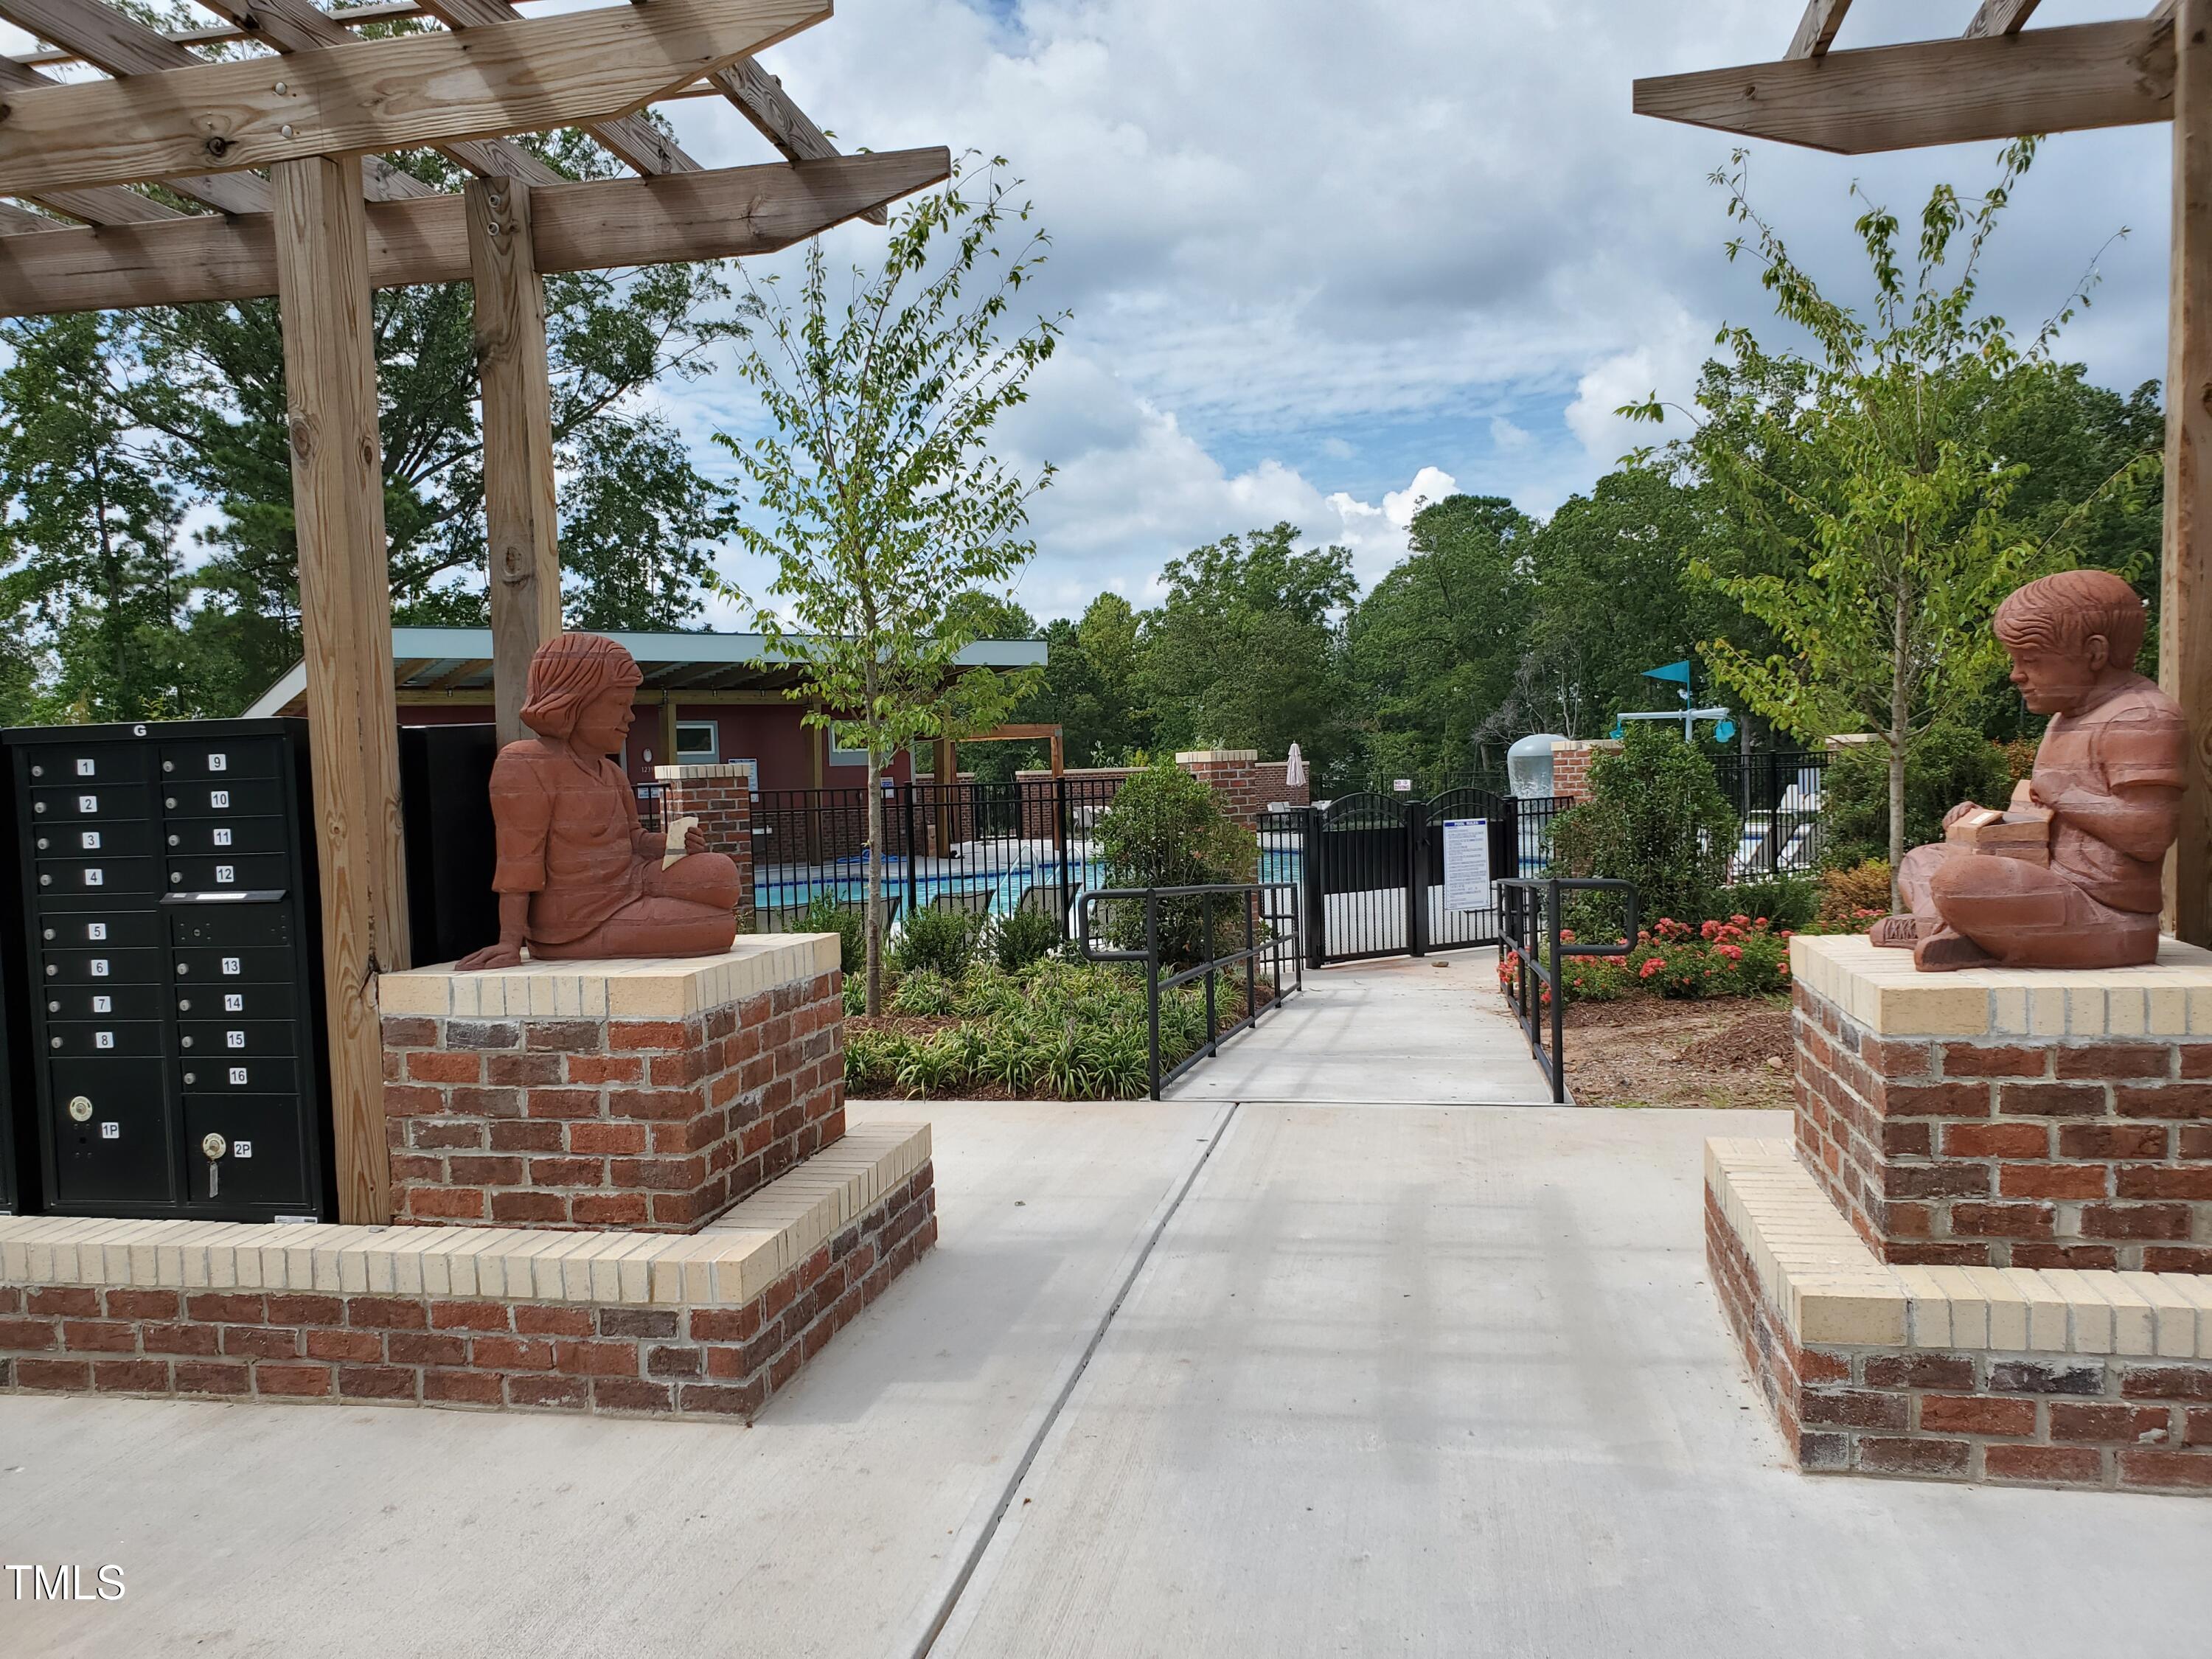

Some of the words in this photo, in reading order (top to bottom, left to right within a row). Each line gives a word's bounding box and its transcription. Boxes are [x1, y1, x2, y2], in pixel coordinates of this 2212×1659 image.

[133, 724, 147, 736] G
[214, 757, 221, 768] 9
[85, 799, 92, 810] 2
[213, 793, 227, 805] 10
[88, 835, 95, 846] 3
[217, 831, 229, 842] 11
[90, 872, 97, 883] 4
[218, 868, 232, 880] 12
[94, 926, 102, 937] 5
[96, 962, 103, 973] 6
[224, 960, 238, 972] 13
[98, 998, 105, 1009] 7
[226, 998, 240, 1009] 14
[101, 1034, 108, 1046] 8
[229, 1034, 243, 1046] 15
[231, 1070, 245, 1082] 16
[103, 1124, 117, 1135] 1P
[236, 1144, 250, 1155] 2P
